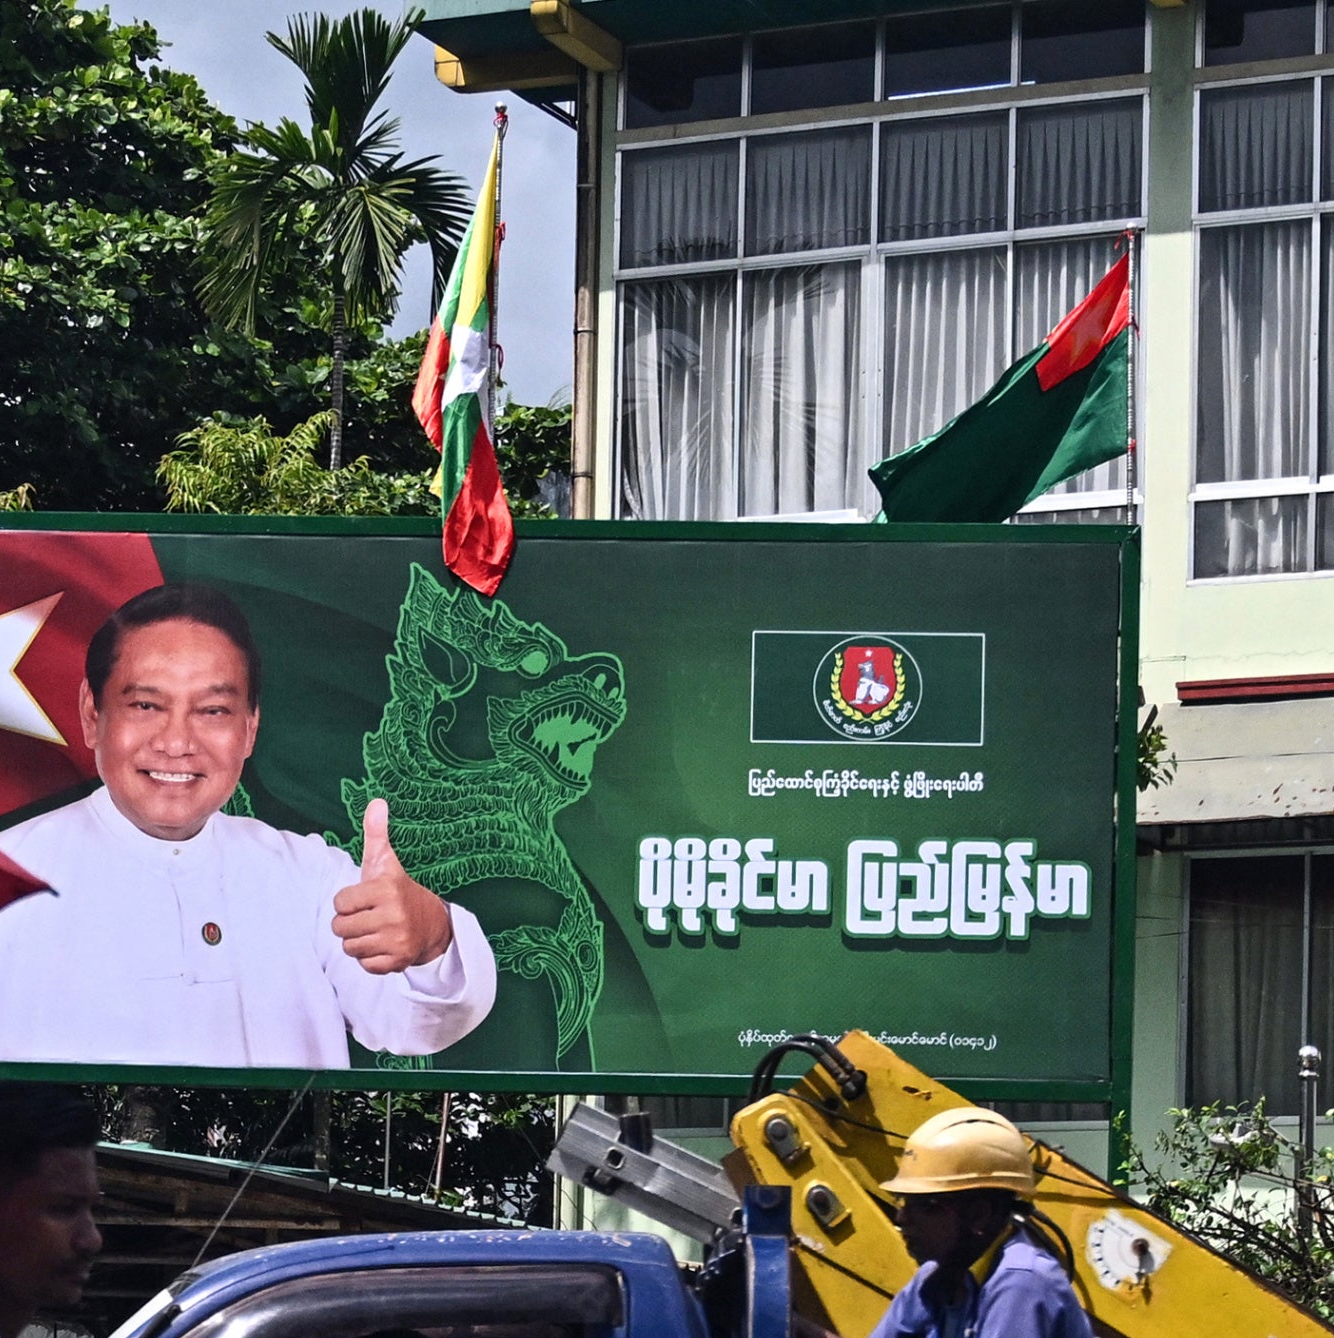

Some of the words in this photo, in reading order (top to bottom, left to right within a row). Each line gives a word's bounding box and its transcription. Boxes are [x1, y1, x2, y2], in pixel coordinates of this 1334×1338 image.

[638, 837, 828, 931] ပိုမိုခိုင်မာ
[846, 840, 1088, 936] ပြည်မြန်မာ
